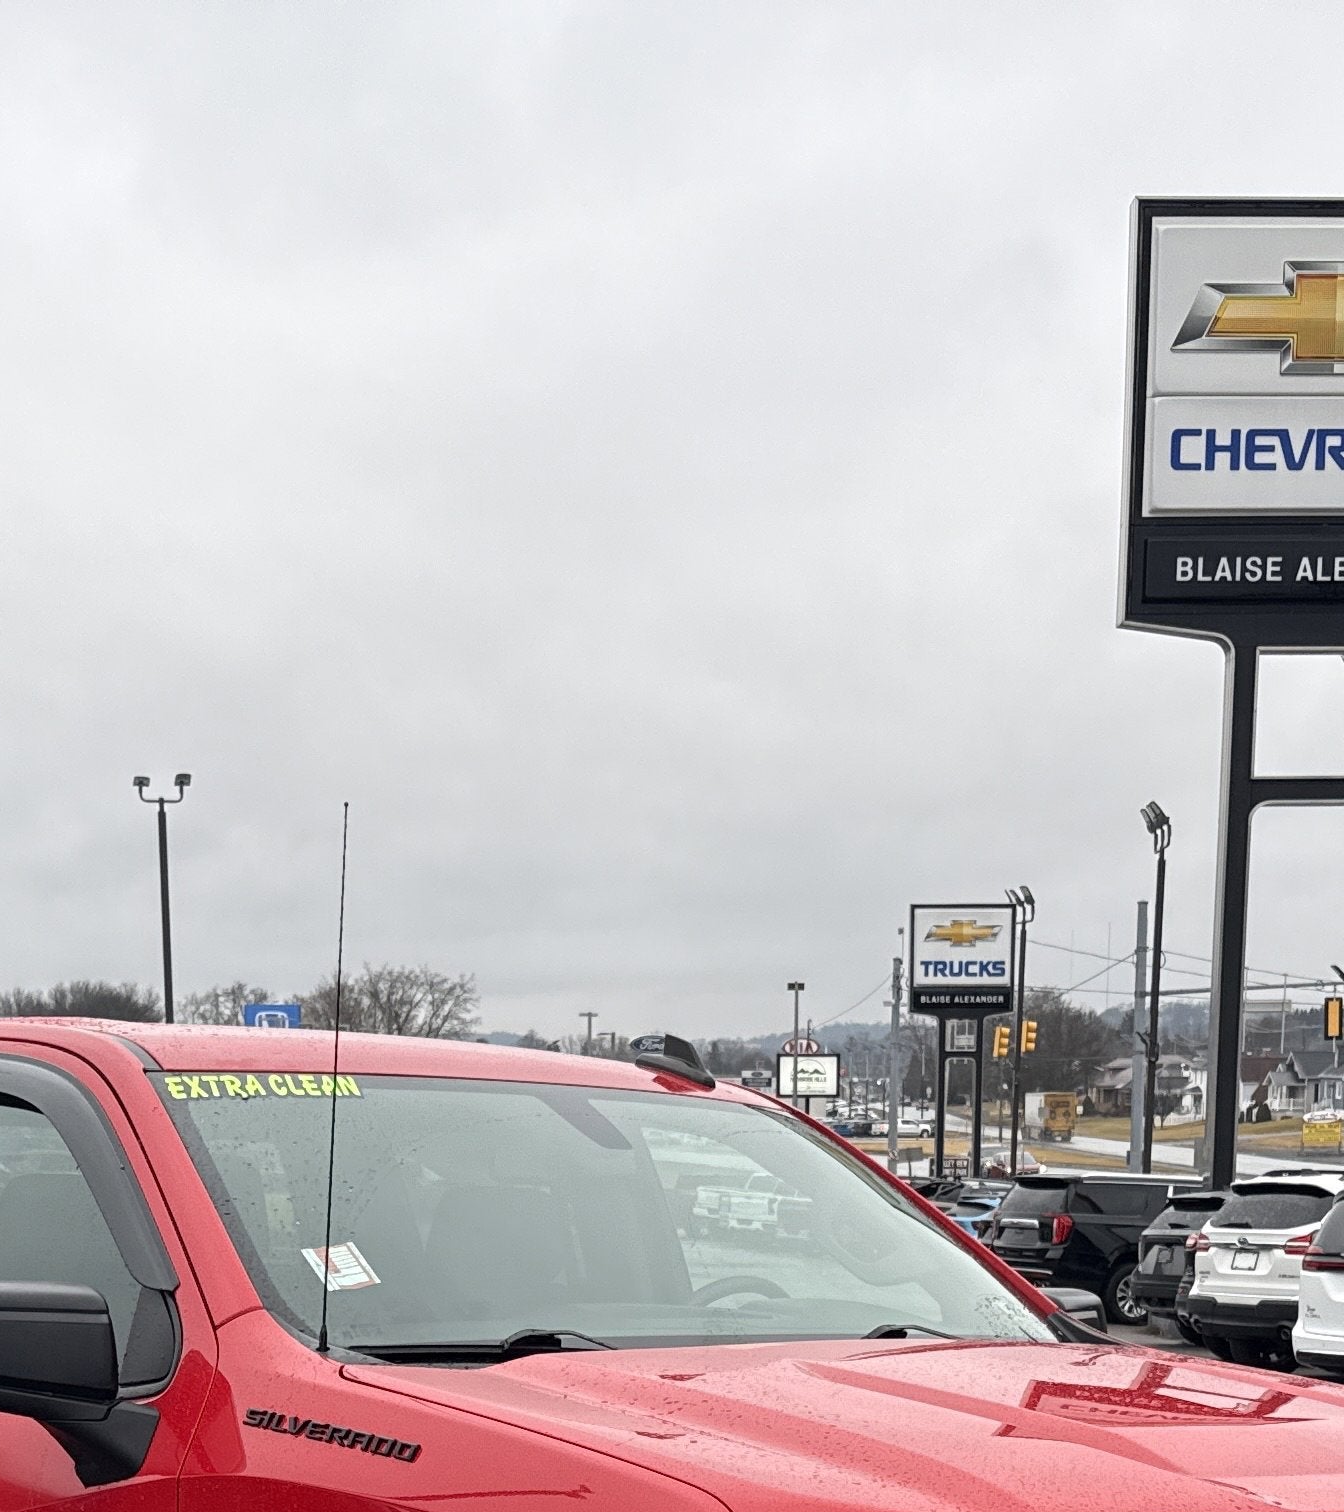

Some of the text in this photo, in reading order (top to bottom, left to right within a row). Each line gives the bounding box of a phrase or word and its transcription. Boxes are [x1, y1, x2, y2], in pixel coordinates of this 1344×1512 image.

[1175, 556, 1283, 583] BLAISE
[920, 960, 1006, 978] TRUCKS
[920, 995, 1004, 1004] BLAISE ALEXANDER
[164, 1074, 362, 1099] EXTRA CLEAN
[242, 1407, 423, 1464] SILVERADO
